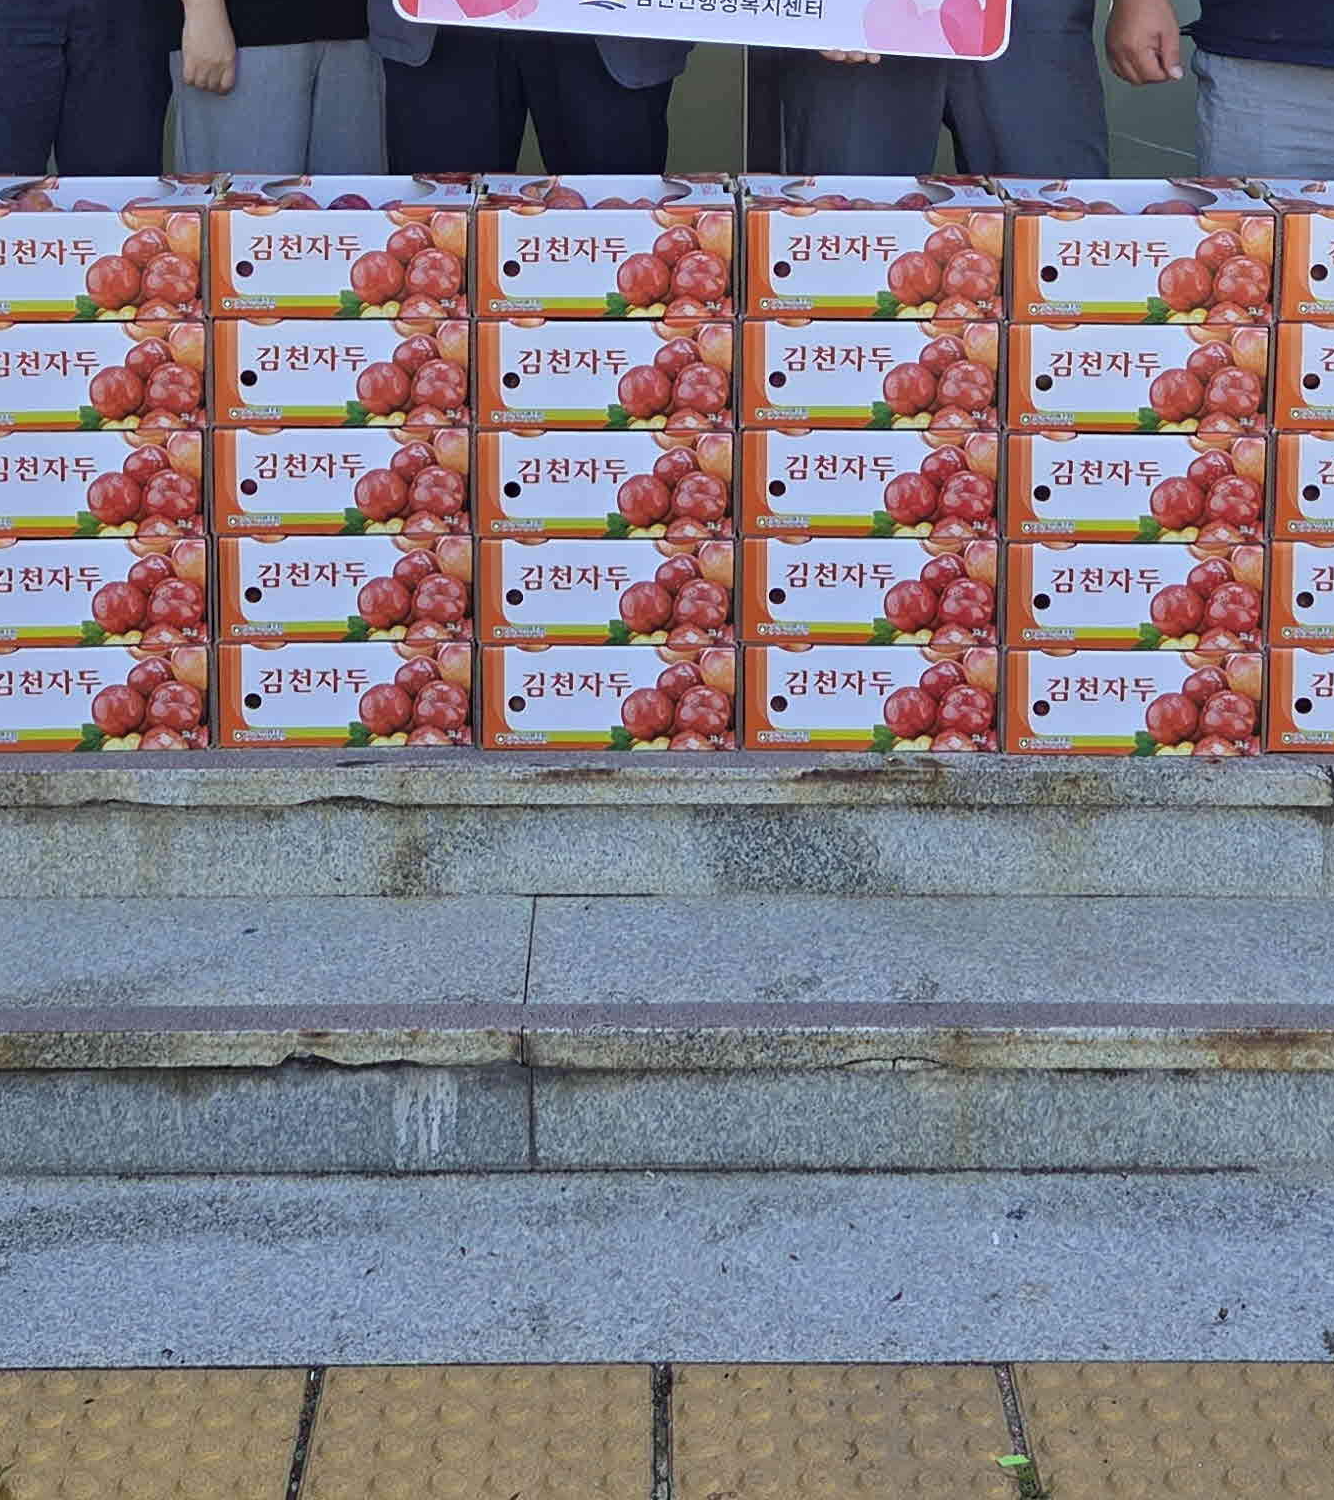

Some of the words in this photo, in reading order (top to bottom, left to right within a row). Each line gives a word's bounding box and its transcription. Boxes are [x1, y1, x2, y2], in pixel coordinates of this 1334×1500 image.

[250, 235, 360, 260] 김천자두
[517, 237, 627, 262] 김천자두
[788, 235, 898, 261] 김천자두
[1059, 241, 1169, 267] 김천자두
[256, 346, 367, 371] 김천자두
[518, 349, 628, 375] 김천자두
[783, 346, 893, 372] 김천자두
[1050, 351, 1160, 378] 김천자두
[255, 454, 365, 479] 김천자두
[518, 459, 627, 484] 김천자두
[785, 455, 895, 481] 김천자두
[1052, 460, 1161, 486] 김천자두
[258, 562, 367, 588] 김천자두
[521, 565, 629, 591] 김천자두
[786, 563, 894, 588] 김천자두
[1051, 568, 1161, 593] 김천자두
[260, 669, 369, 693] 김천자두
[523, 672, 631, 697] 김천자두
[786, 670, 895, 695] 김천자두
[1047, 677, 1156, 702] 김천자두
